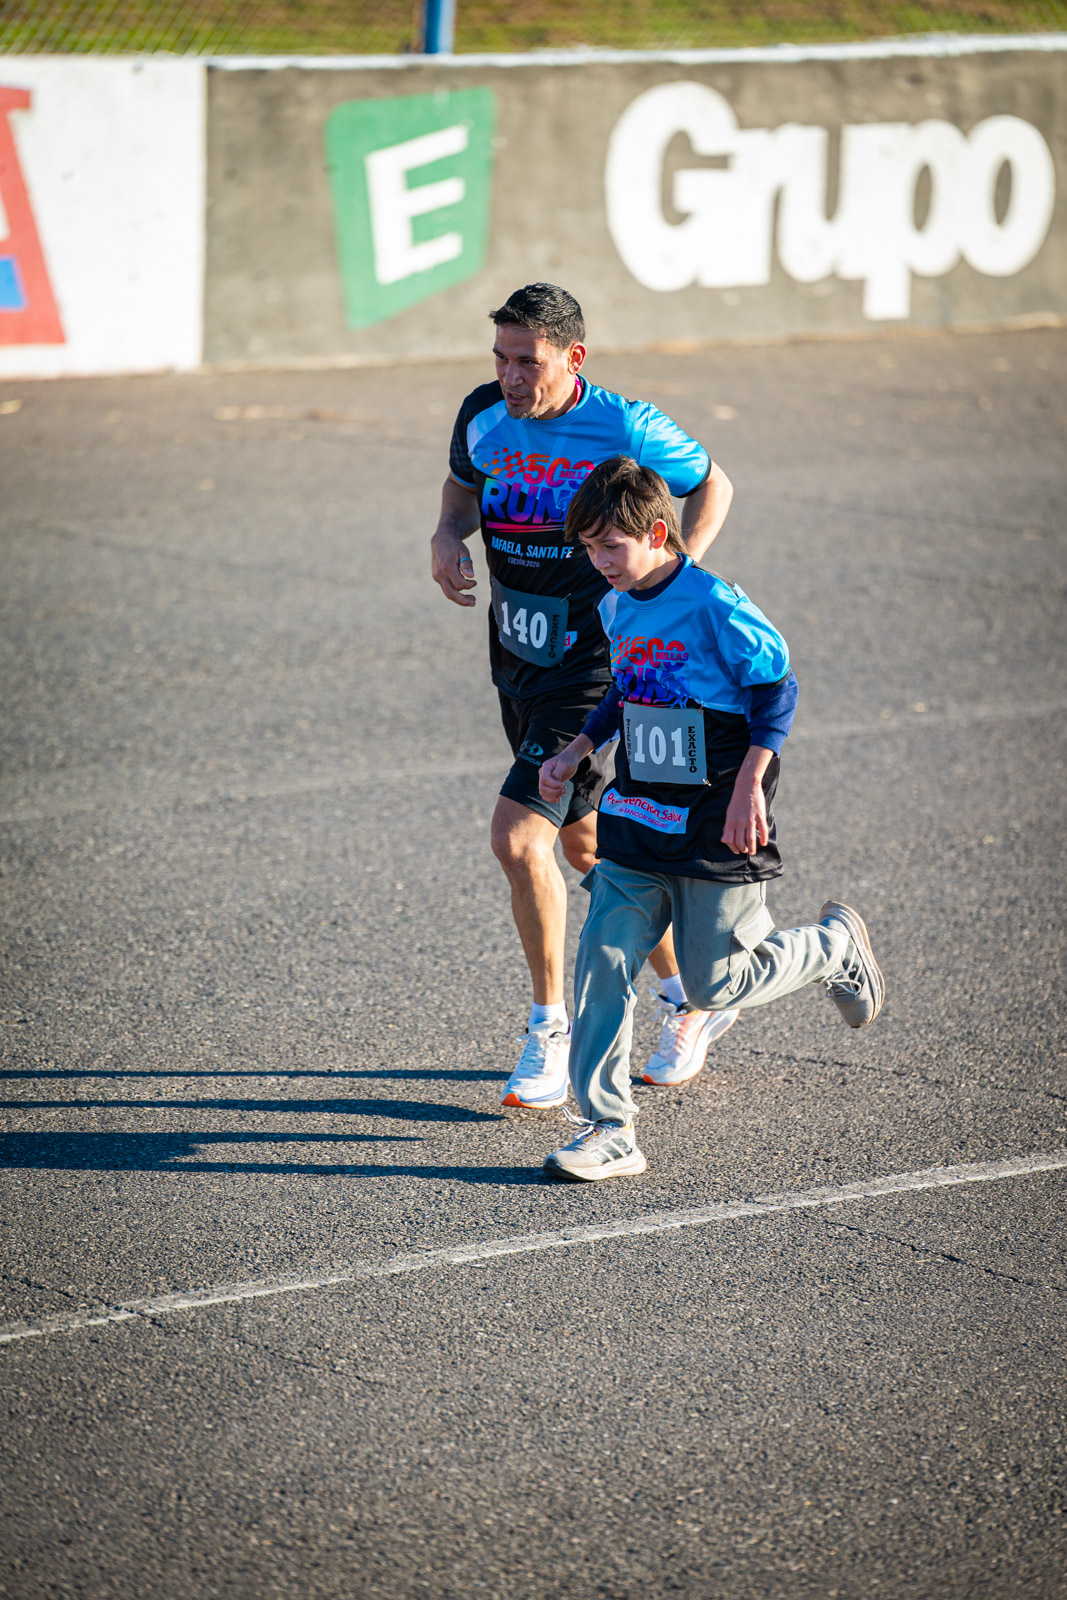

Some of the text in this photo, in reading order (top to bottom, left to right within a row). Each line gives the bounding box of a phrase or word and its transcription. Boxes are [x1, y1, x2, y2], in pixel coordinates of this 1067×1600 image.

[364, 124, 469, 286] E
[605, 80, 1056, 320] Grupo
[559, 470, 590, 480] MILL
[491, 535, 575, 559] RAFAELA, SANTA FE
[501, 601, 548, 649] 140
[548, 614, 560, 659] EXACTO
[627, 636, 686, 672] 500
[655, 651, 689, 662] MILLAS
[634, 723, 686, 767] 101
[687, 726, 698, 774] EXACTO
[624, 807, 647, 820] SANCOR
